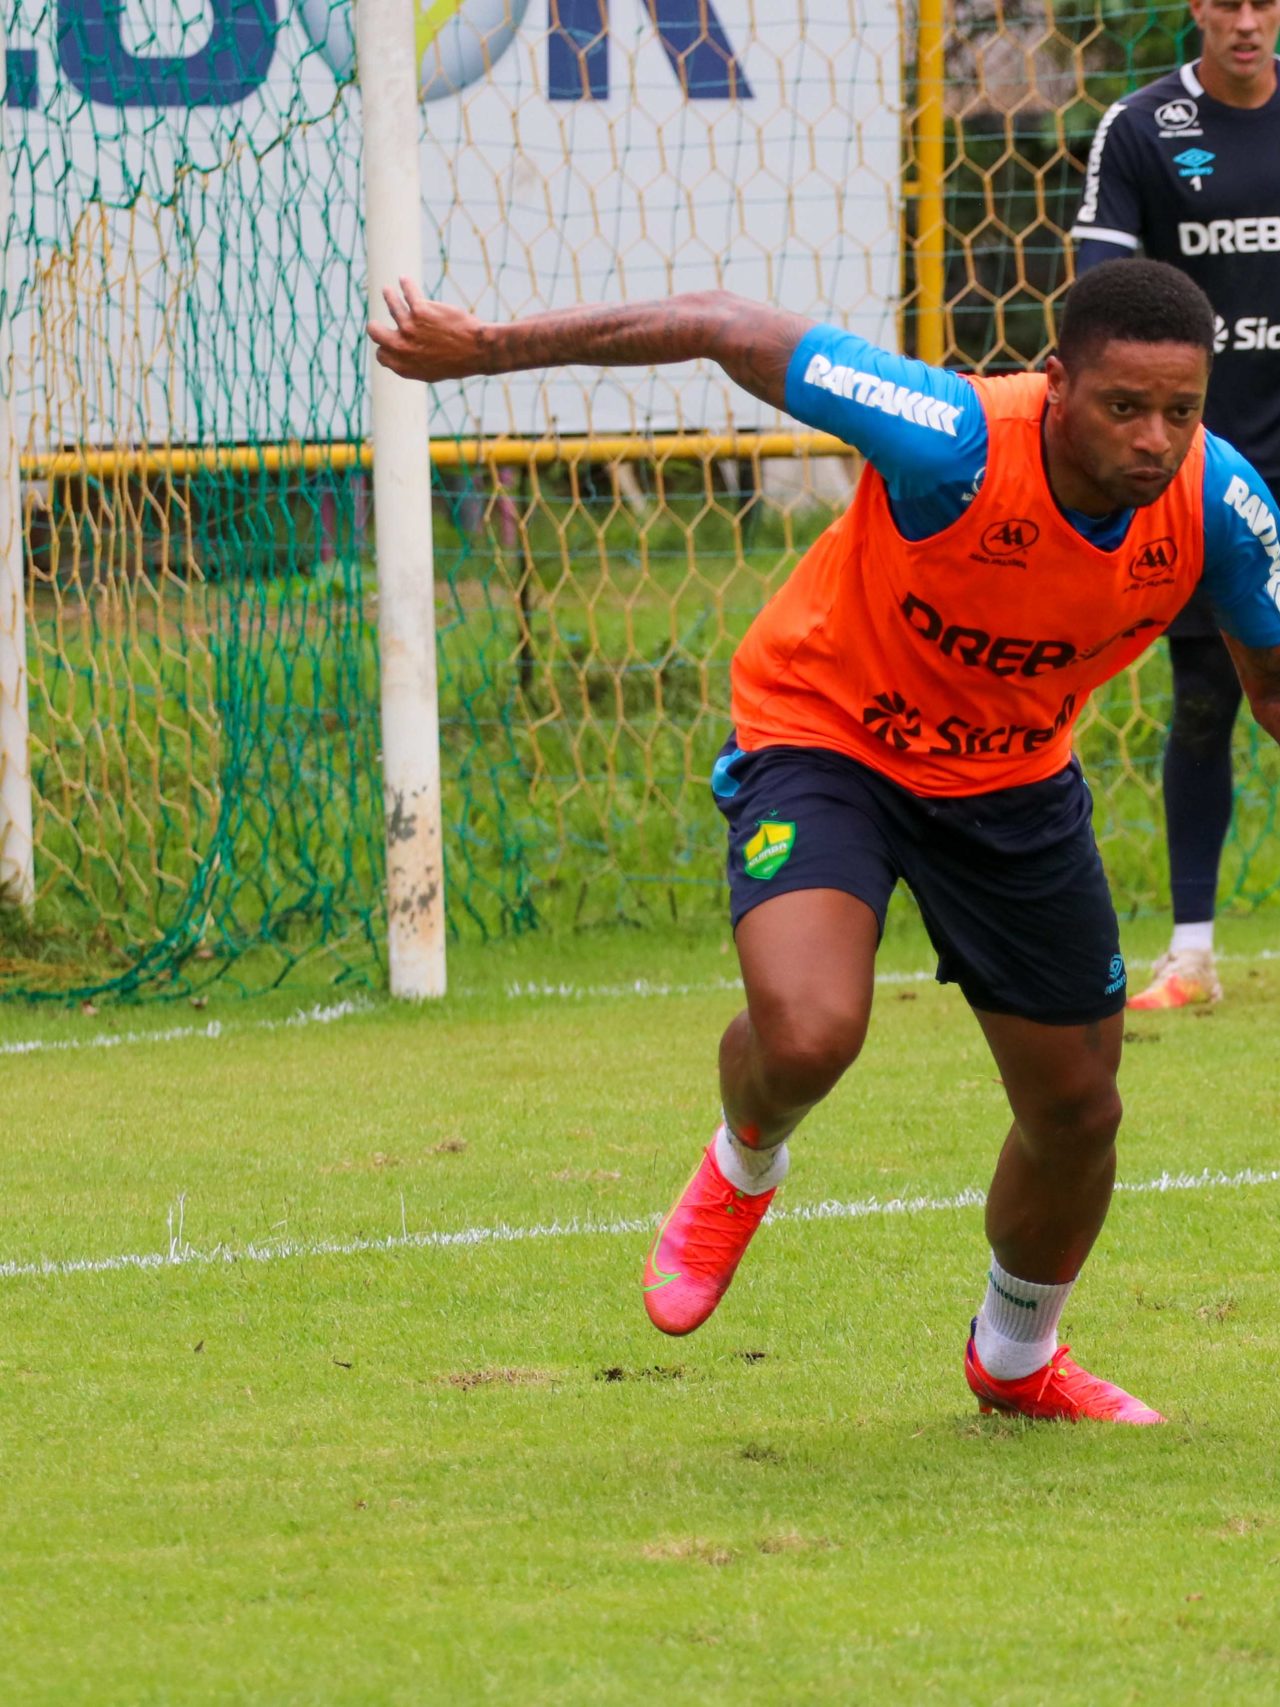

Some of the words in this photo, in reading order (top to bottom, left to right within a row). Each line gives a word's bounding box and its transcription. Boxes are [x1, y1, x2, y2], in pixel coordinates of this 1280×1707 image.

[1189, 175, 1202, 191] 1
[804, 354, 959, 437] RAYTAK
[901, 591, 1160, 677] DREB
